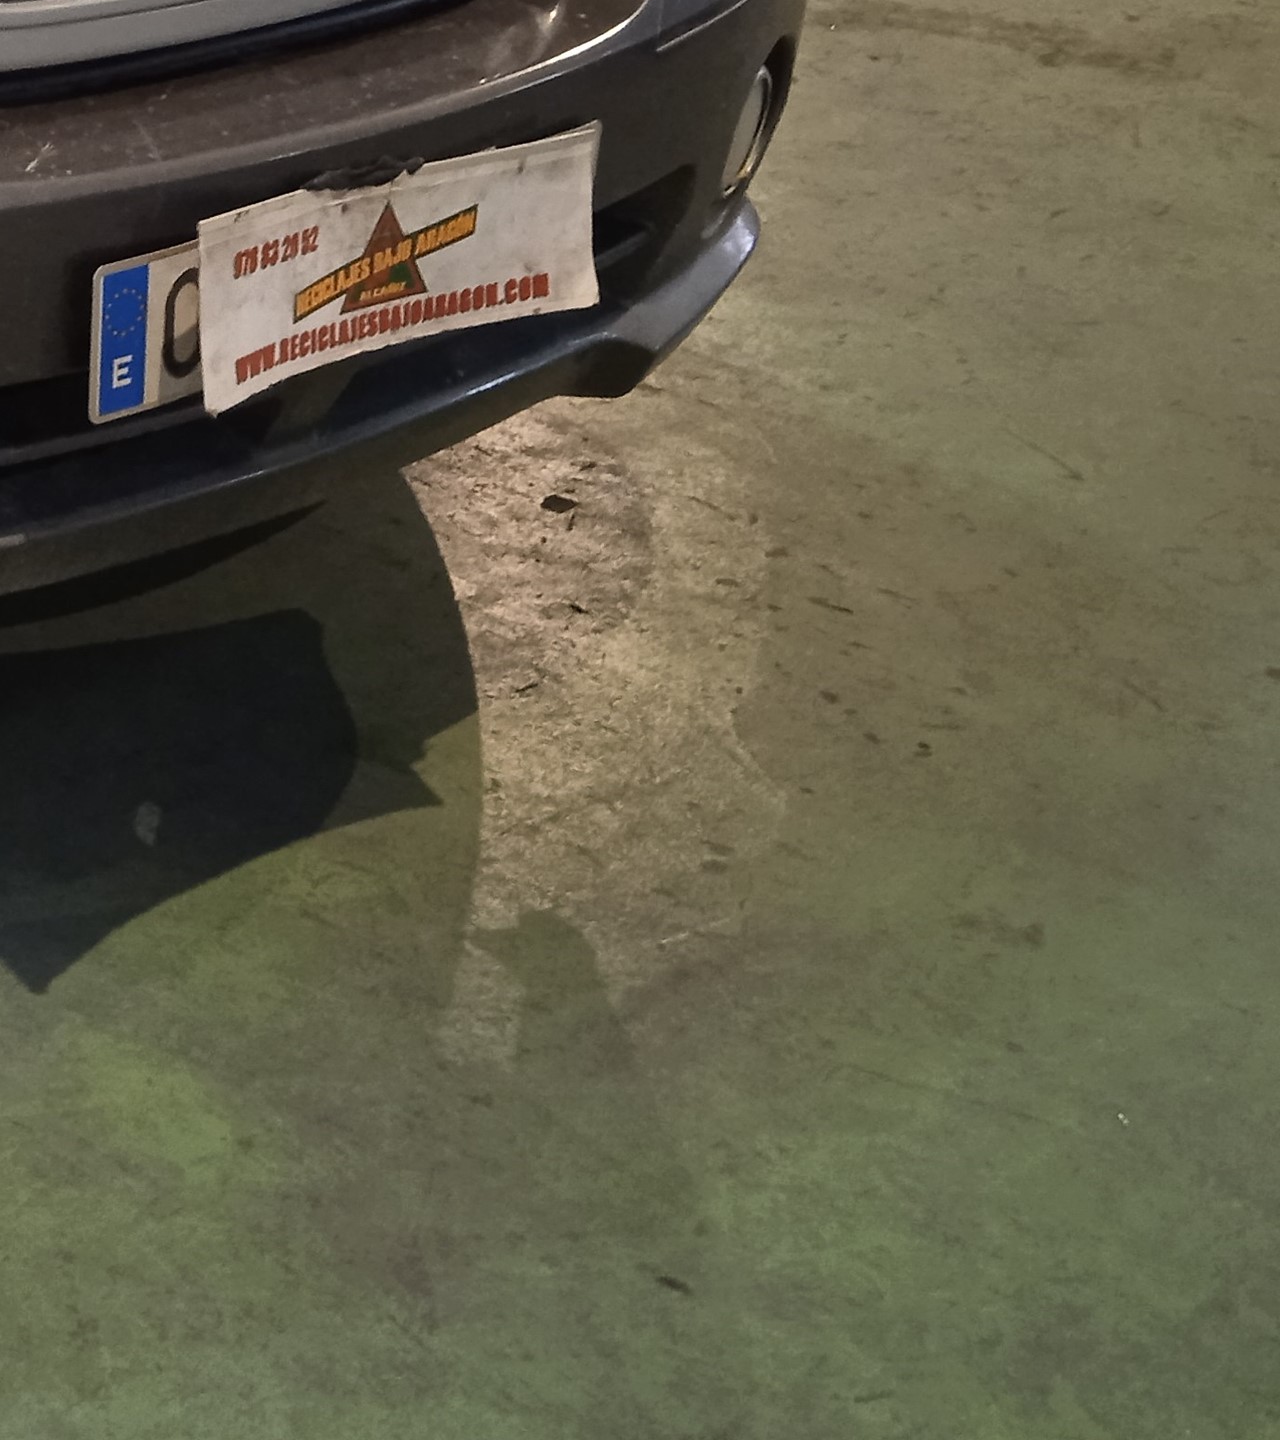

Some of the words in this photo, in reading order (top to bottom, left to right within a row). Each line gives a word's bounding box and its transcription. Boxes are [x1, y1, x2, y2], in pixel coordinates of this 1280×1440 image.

[296, 257, 371, 317] RECICLAJES
[373, 238, 412, 274] BAJO
[112, 354, 133, 389] E
